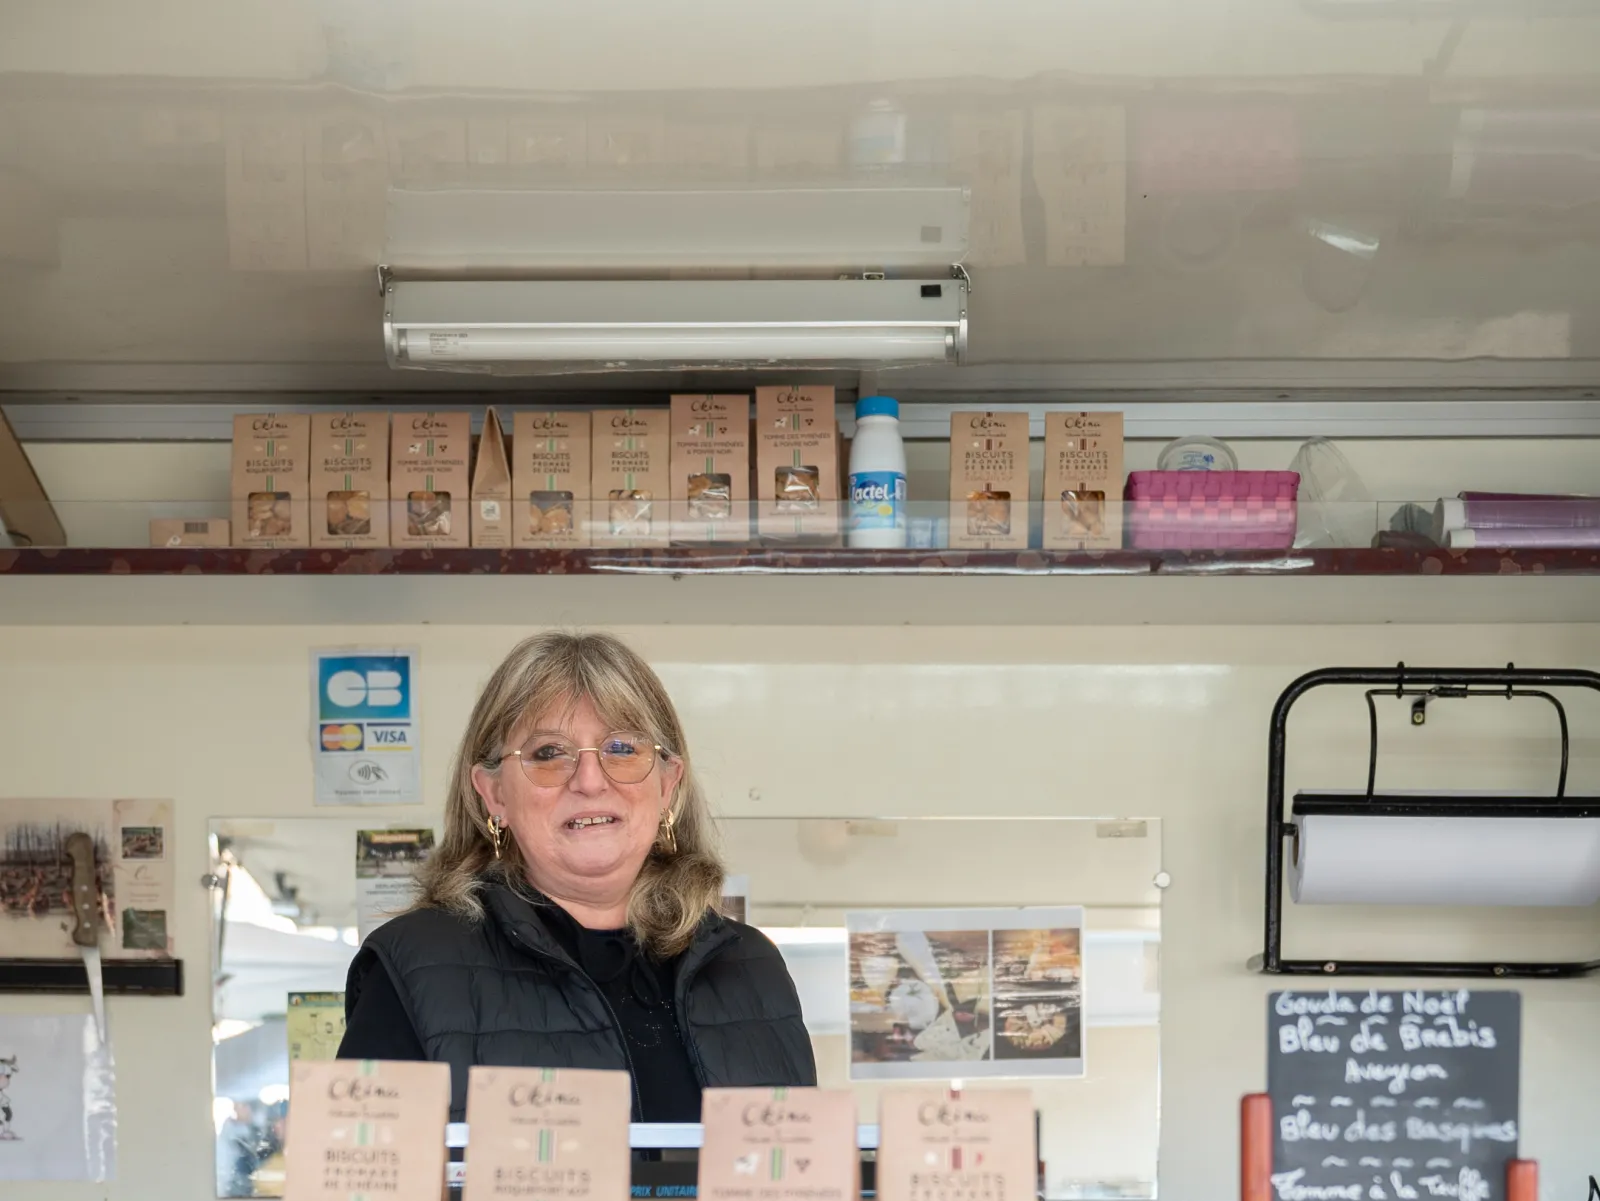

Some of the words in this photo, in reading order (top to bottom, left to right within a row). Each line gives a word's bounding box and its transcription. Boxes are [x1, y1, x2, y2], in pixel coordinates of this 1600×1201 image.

[324, 458, 372, 466] BISCUITS
[965, 451, 1014, 459] BISCUITS
[1059, 451, 1108, 459] BISCUITS
[246, 459, 294, 467] BISCUITS
[852, 484, 889, 502] lactel
[372, 731, 407, 743] VISA
[1275, 988, 1357, 1016] Gouda
[1360, 988, 1393, 1013] de
[1279, 1016, 1340, 1053] Bleu
[1350, 1020, 1388, 1054] de
[1399, 1016, 1497, 1051] Brebis
[1345, 1058, 1448, 1094] Aveyron
[1280, 1109, 1340, 1142] Bleu
[1344, 1108, 1397, 1142] des
[324, 1150, 399, 1163] BISCUITS
[494, 1168, 591, 1183] BISCUITS
[911, 1173, 1004, 1187] BISCUITS
[631, 1184, 652, 1198] PRIX
[656, 1184, 698, 1198] UNITAIR
[1270, 1167, 1363, 1201] Tomme
[1390, 1170, 1419, 1200] la
